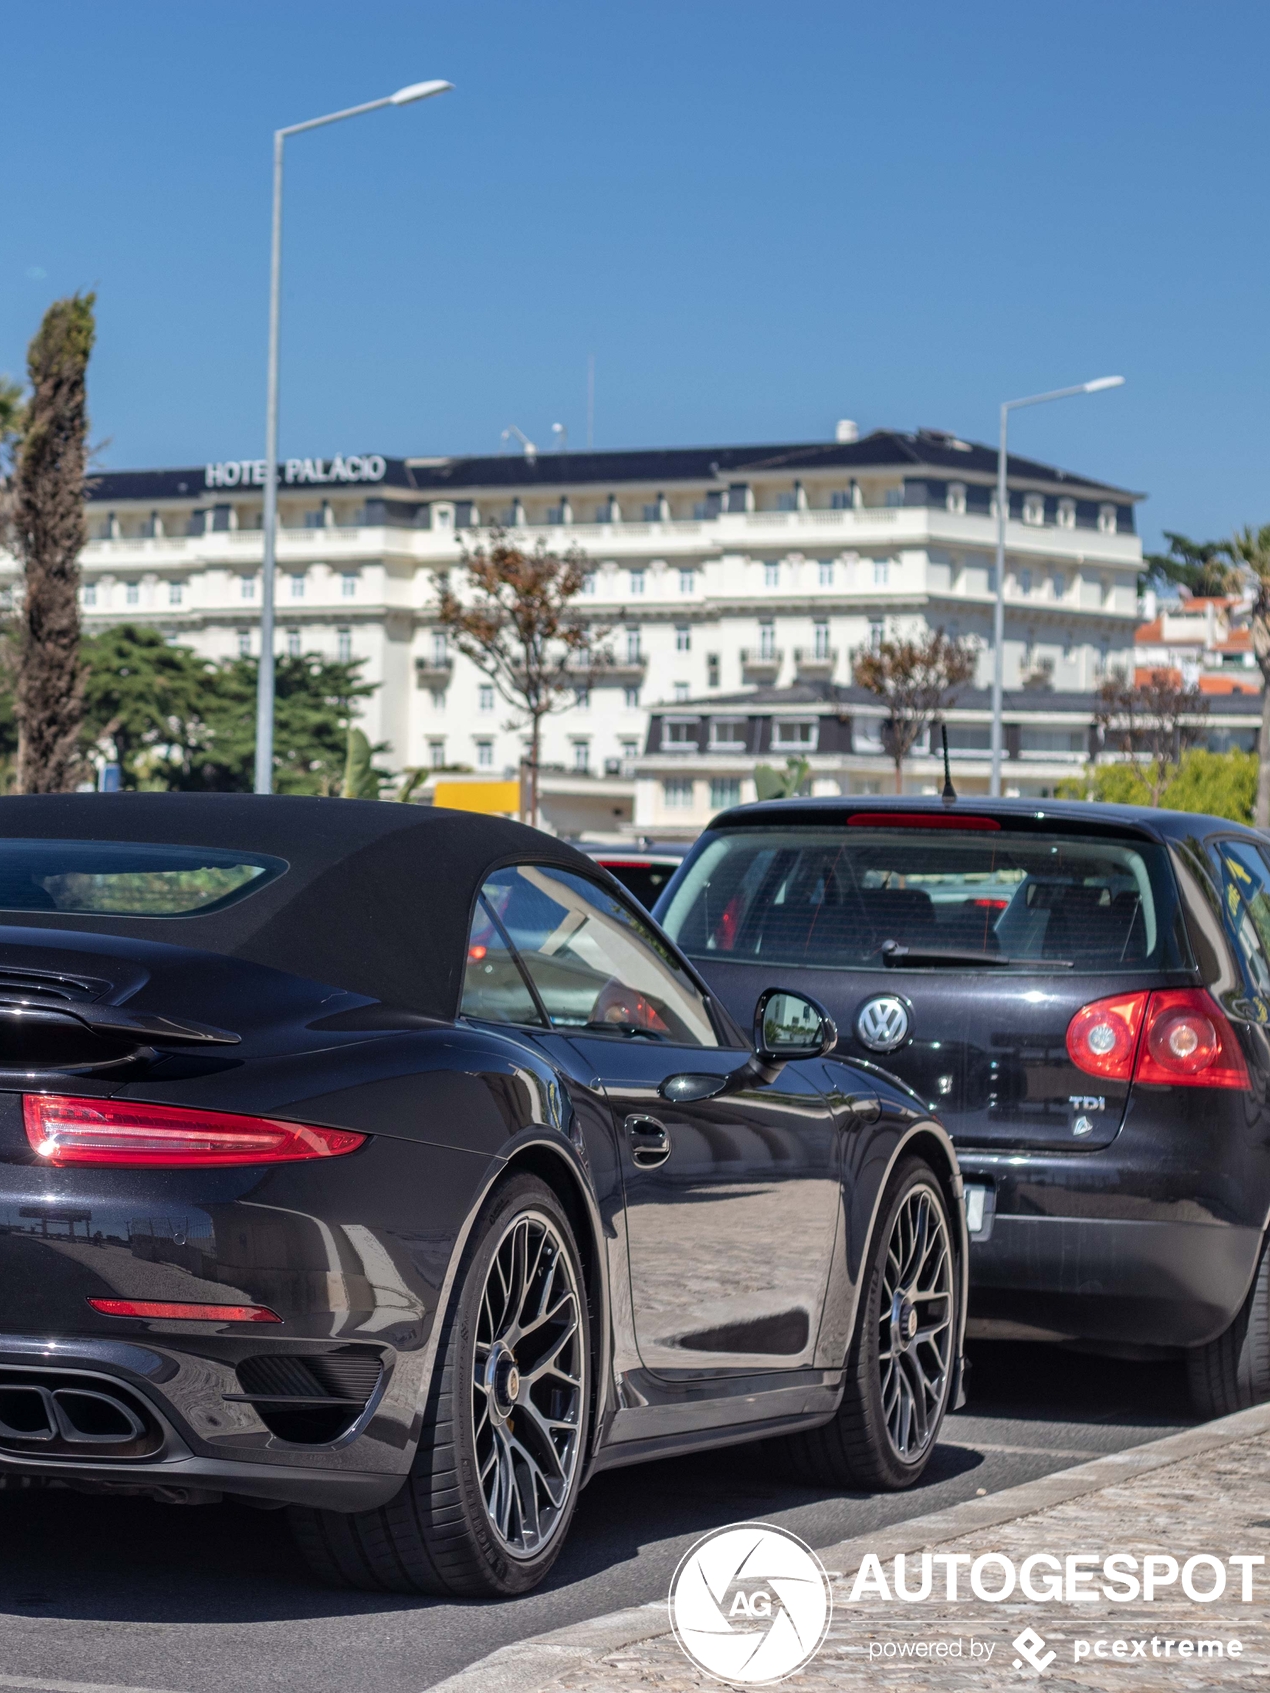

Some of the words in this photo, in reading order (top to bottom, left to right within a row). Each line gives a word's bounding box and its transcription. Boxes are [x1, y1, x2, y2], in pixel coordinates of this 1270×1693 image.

[205, 459, 281, 488] HOTE
[285, 452, 387, 484] PALÁCIO
[1069, 1096, 1106, 1111] TDI
